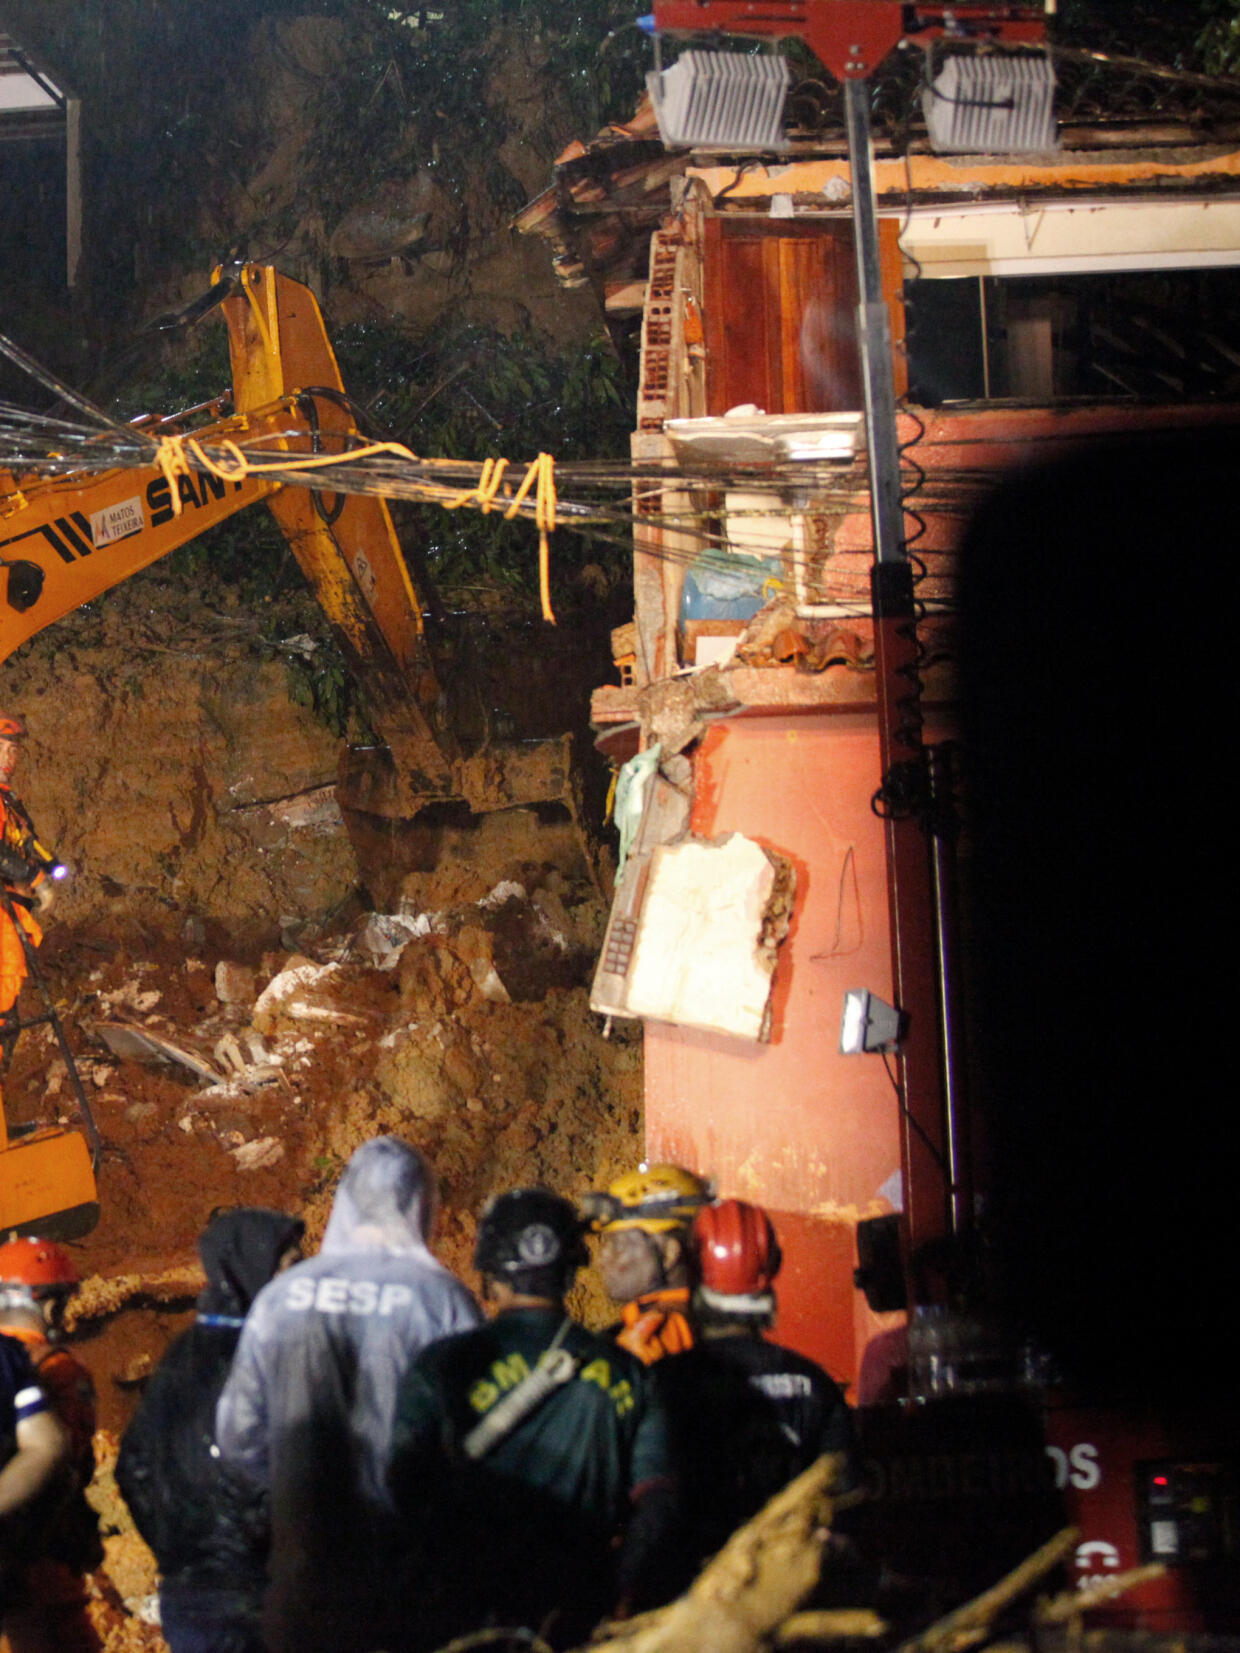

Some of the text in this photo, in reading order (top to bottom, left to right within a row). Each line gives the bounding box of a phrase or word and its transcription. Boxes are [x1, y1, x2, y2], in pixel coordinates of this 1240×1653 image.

[110, 505, 134, 522] MATOS
[112, 516, 143, 537] TEIXEIRA
[285, 1276, 413, 1316] SESP
